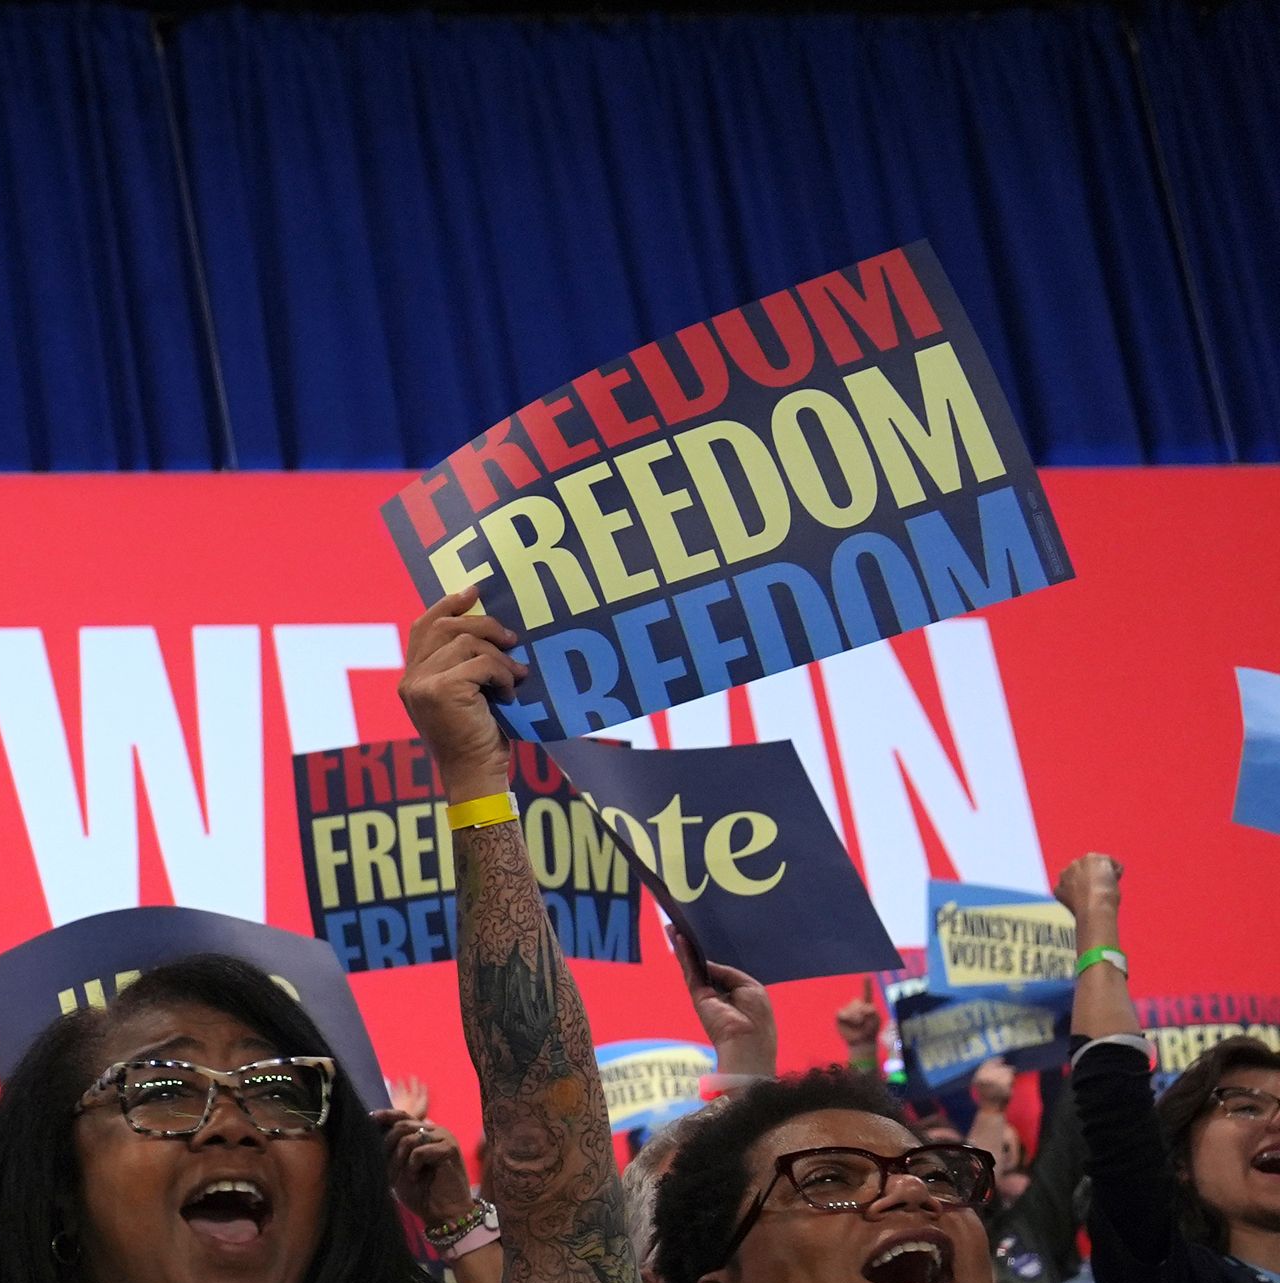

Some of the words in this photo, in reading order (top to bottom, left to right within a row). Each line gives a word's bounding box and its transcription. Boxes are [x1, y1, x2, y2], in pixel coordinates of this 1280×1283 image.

[397, 247, 943, 549] FREEDOM
[428, 341, 1007, 630] FREEDOM
[582, 792, 787, 903] ote
